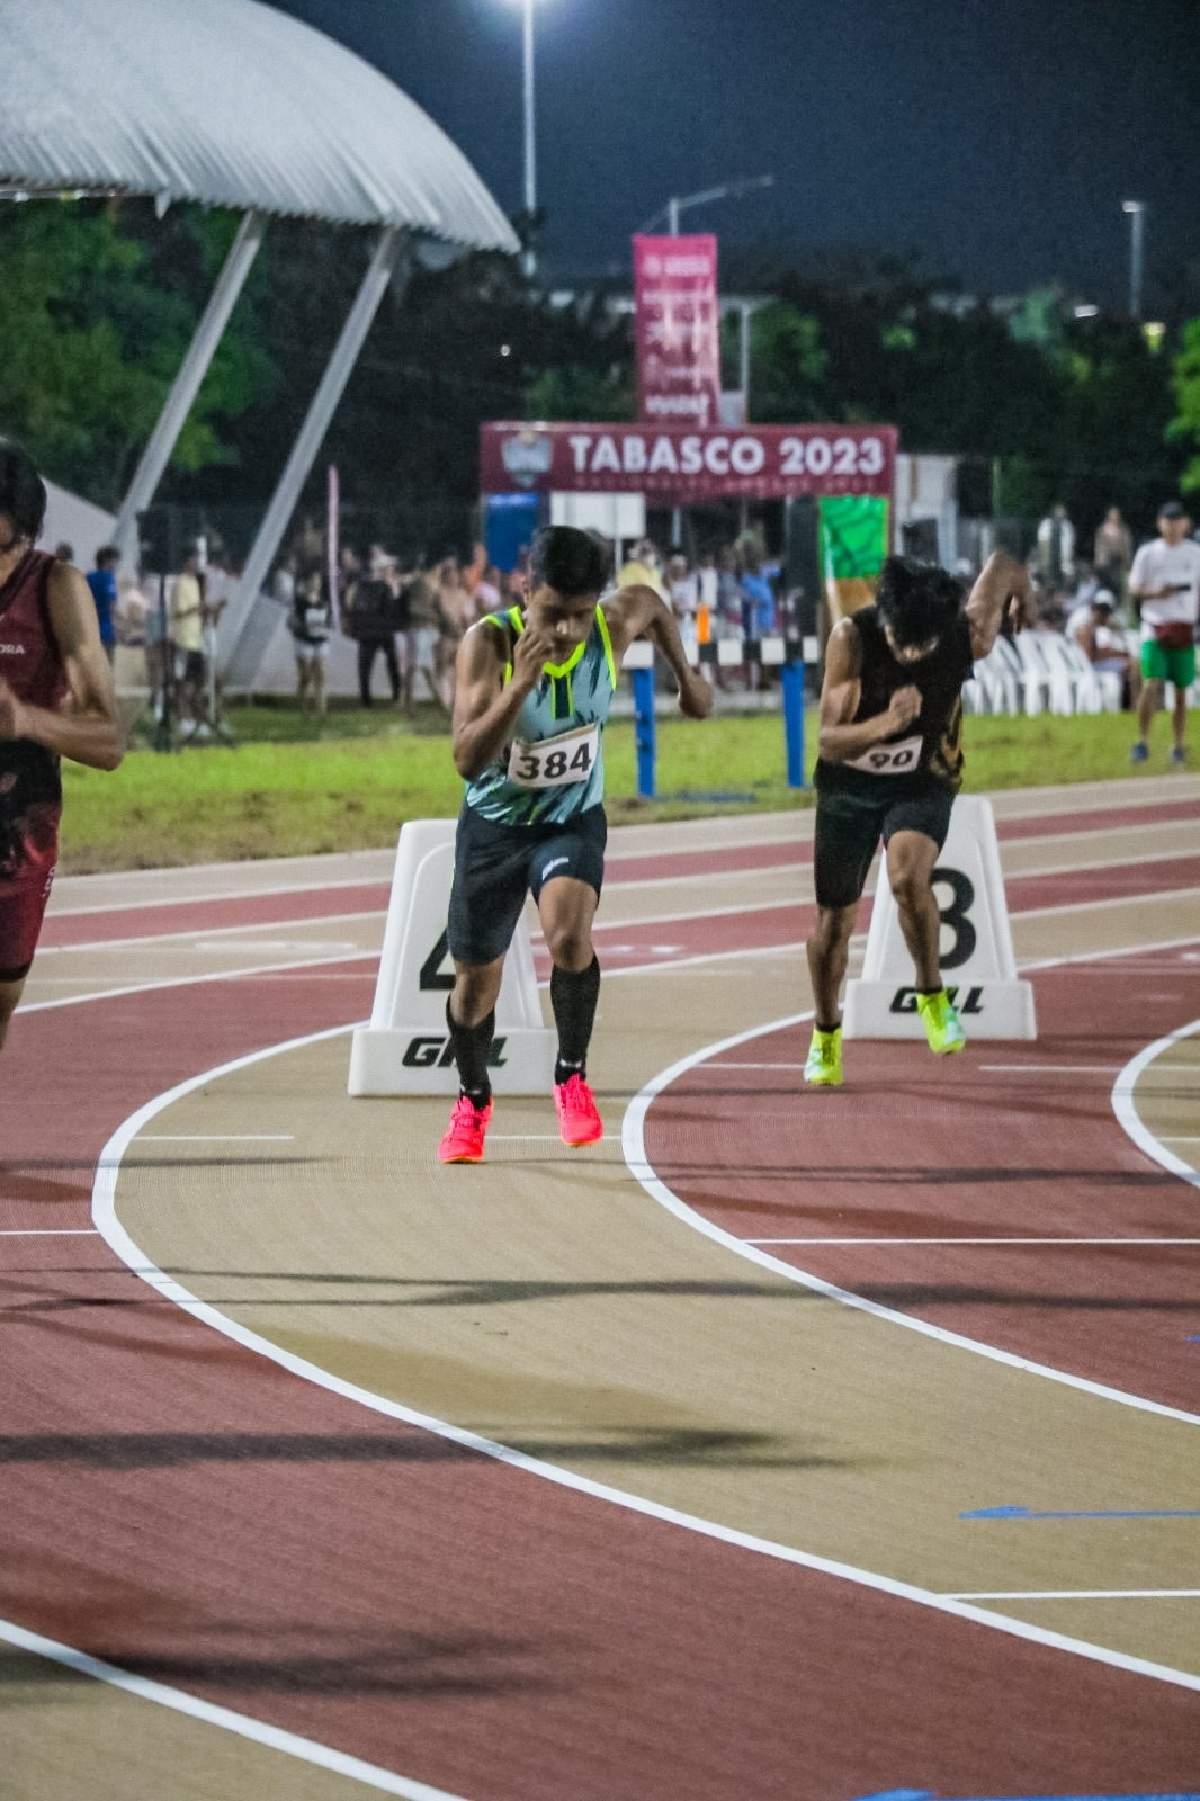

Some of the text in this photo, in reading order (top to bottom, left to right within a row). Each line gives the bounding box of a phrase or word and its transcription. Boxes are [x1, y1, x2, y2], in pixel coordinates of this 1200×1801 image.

[568, 435, 885, 476] TABASCO 2023
[516, 742, 592, 780] 384
